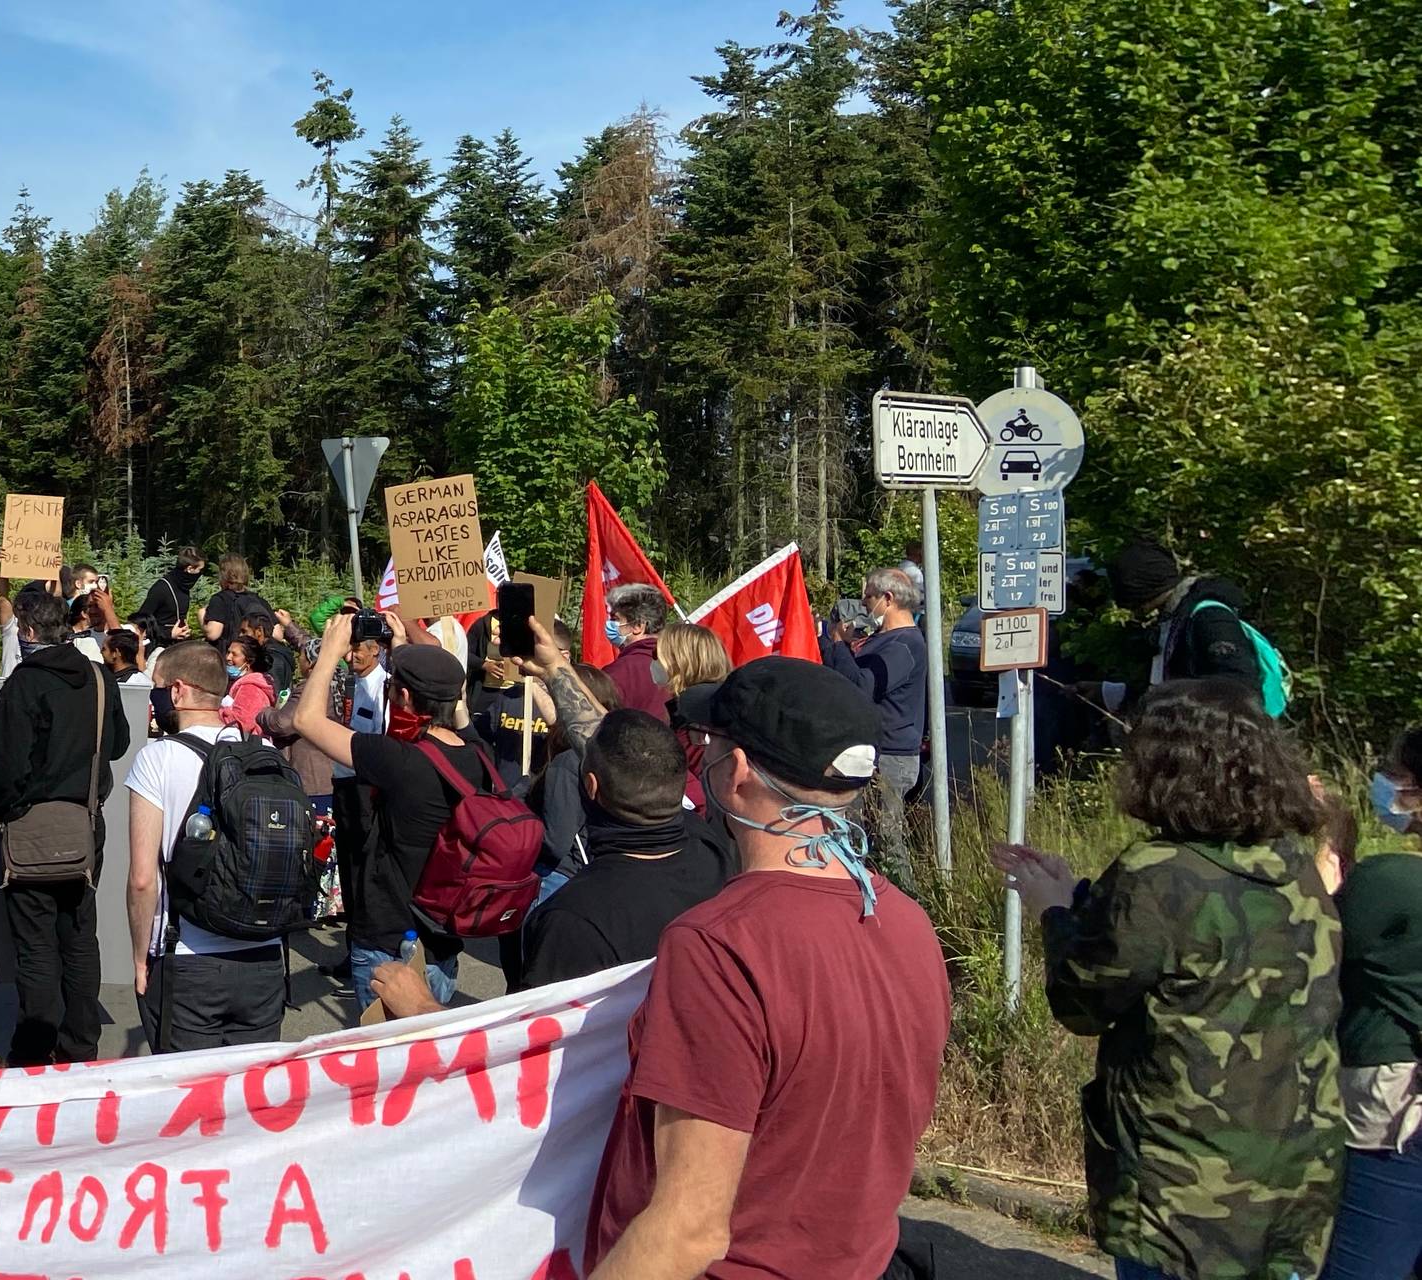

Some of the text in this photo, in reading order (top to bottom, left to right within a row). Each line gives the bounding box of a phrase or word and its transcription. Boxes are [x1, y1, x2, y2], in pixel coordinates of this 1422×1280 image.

[892, 411, 959, 446] Kläranlage
[897, 445, 957, 473] Bornheim
[393, 482, 464, 507] GERMAN
[989, 503, 1017, 515] S 100
[1030, 499, 1058, 511] S 100
[392, 500, 477, 528] ASPARAGUS
[410, 524, 470, 543] TASTES
[418, 545, 459, 563] LIKE
[397, 559, 485, 584] EXPLOITATION
[1006, 558, 1016, 571] S
[1020, 561, 1036, 570] 100
[1041, 565, 1058, 573] und
[429, 586, 475, 602] BEYOND
[1040, 592, 1056, 601] frei
[432, 601, 475, 616] EUROPE
